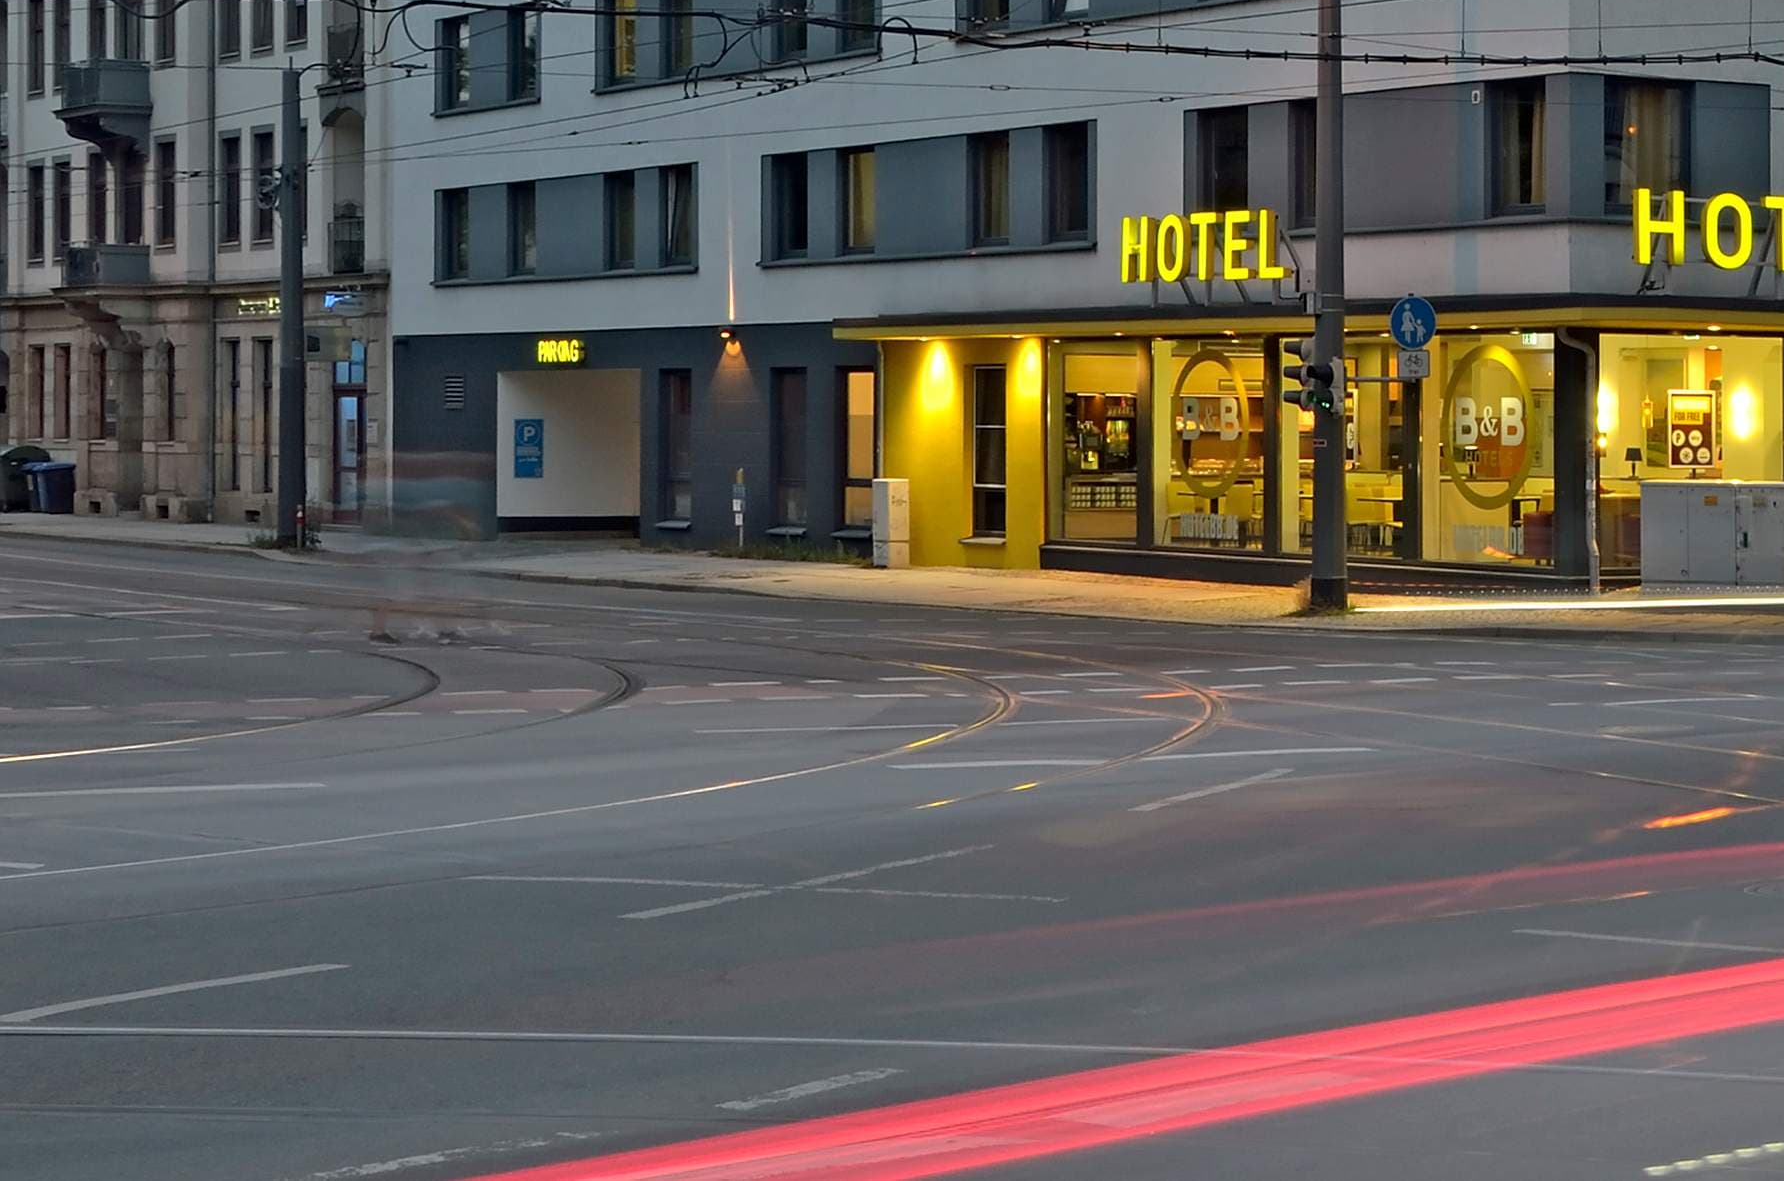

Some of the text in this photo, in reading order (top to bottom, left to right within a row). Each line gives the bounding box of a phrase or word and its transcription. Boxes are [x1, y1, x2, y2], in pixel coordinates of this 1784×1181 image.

[1121, 208, 1288, 283] HOTEL
[523, 425, 535, 441] P
[1182, 397, 1240, 441] B&B
[1455, 396, 1525, 447] B&B
